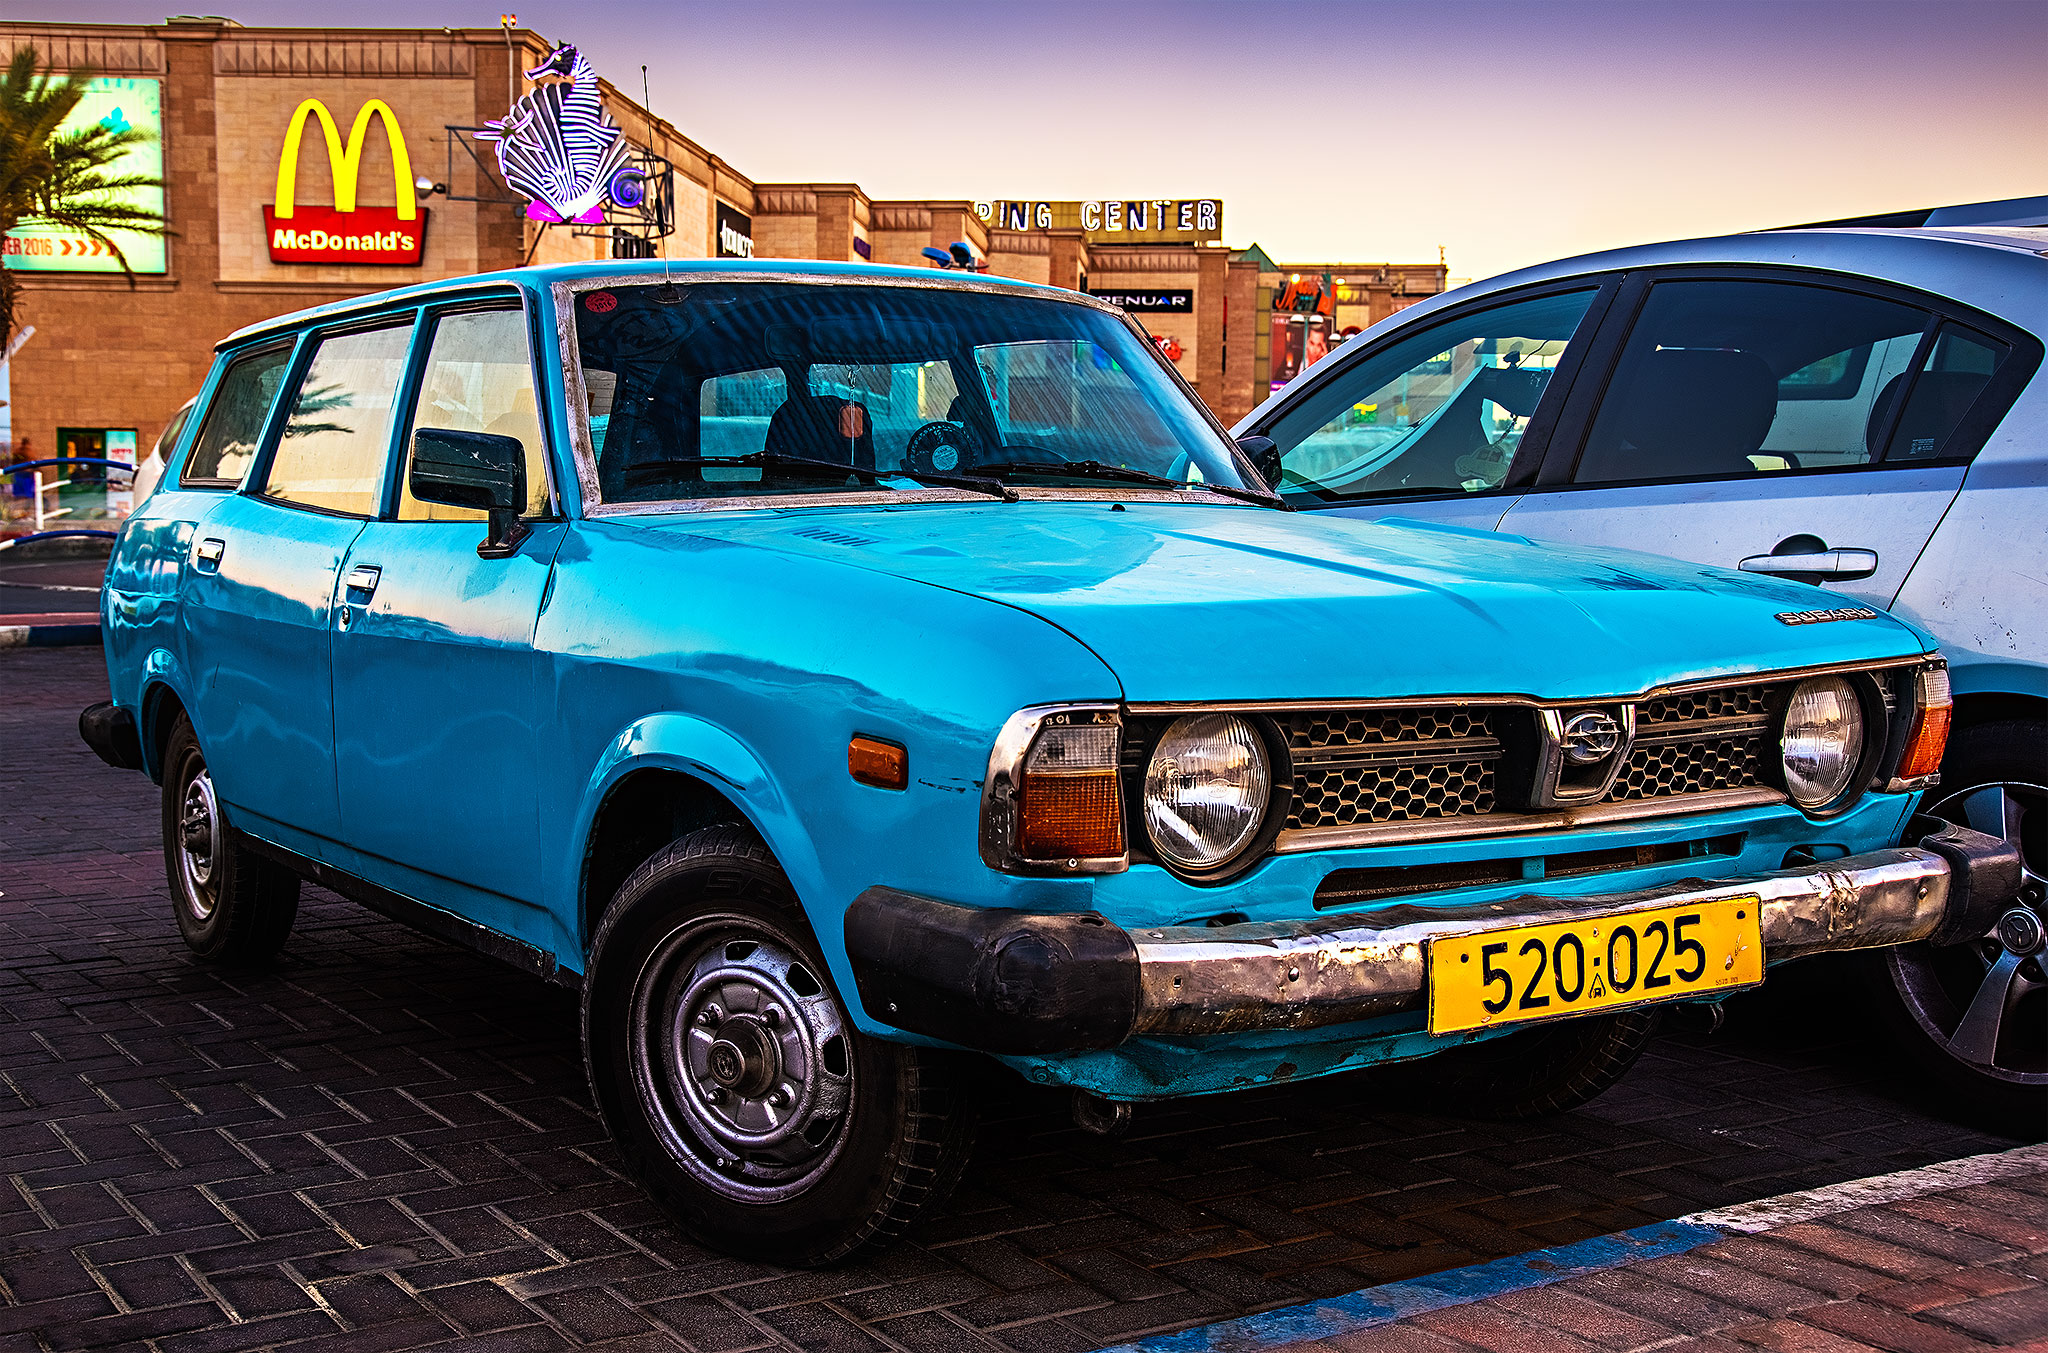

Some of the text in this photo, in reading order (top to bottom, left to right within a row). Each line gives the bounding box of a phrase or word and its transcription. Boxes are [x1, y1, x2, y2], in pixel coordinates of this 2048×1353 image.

[973, 200, 1217, 232] PING CENTER
[24, 238, 52, 255] 2016
[273, 229, 415, 251] McDonald's
[1774, 607, 1878, 626] SUBARU
